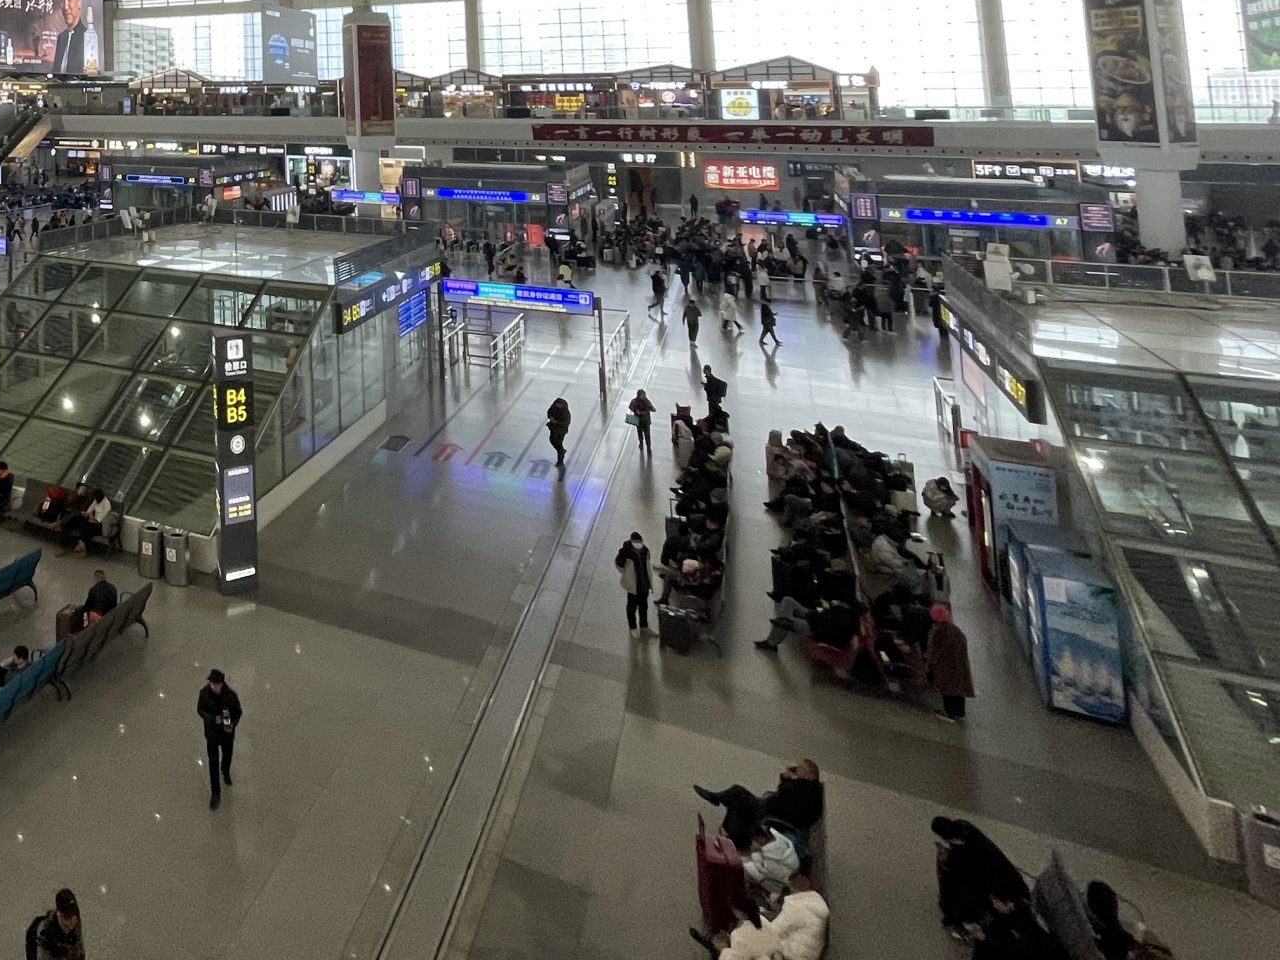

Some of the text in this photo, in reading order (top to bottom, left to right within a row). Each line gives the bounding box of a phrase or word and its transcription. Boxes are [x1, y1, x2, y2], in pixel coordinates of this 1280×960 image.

[722, 165, 776, 178] 新亚电缆
[974, 164, 995, 176] 3F
[226, 387, 246, 406] B4
[226, 405, 248, 424] B5
